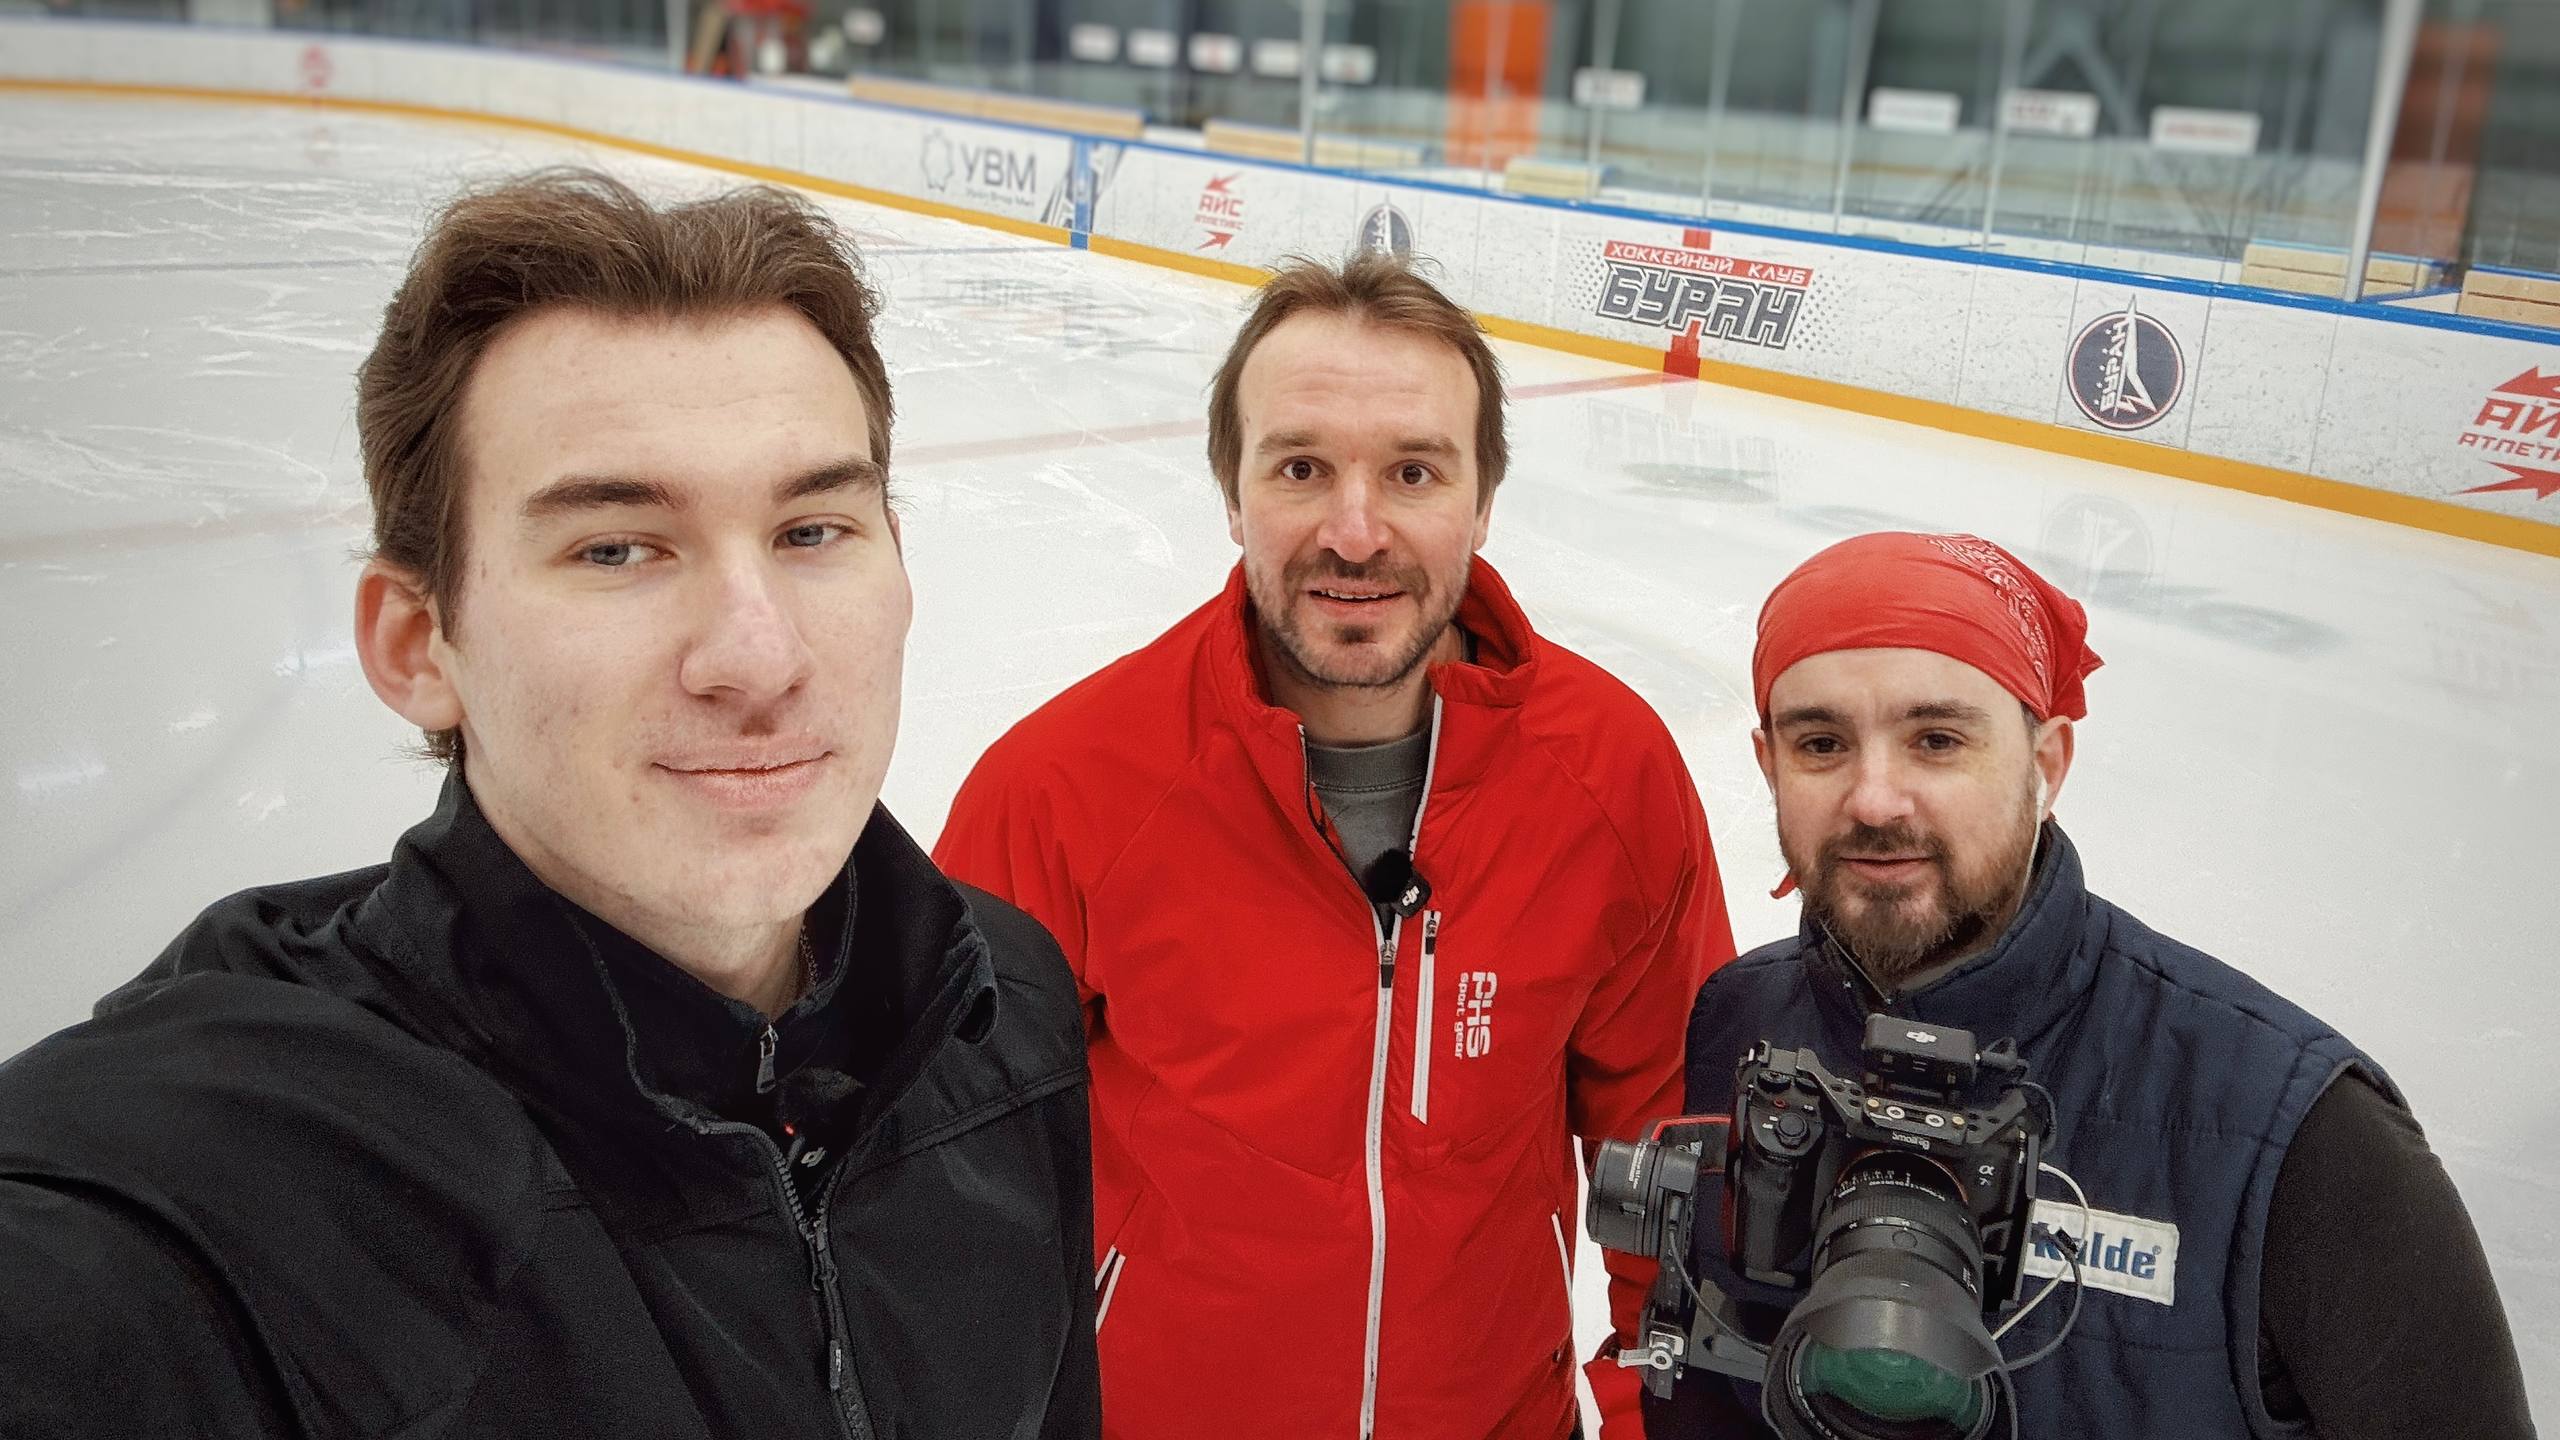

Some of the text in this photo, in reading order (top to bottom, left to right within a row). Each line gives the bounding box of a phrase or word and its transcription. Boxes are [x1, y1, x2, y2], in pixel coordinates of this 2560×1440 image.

[961, 143, 1036, 193] УВМ
[1611, 243, 1808, 285] ХОККЕЙНЫЙ КЛУБ
[1597, 259, 1806, 349] БУРАН
[2473, 397, 2560, 439] АЙ
[1454, 972, 1469, 1060] sport gear
[1466, 971, 1498, 1058] PHS
